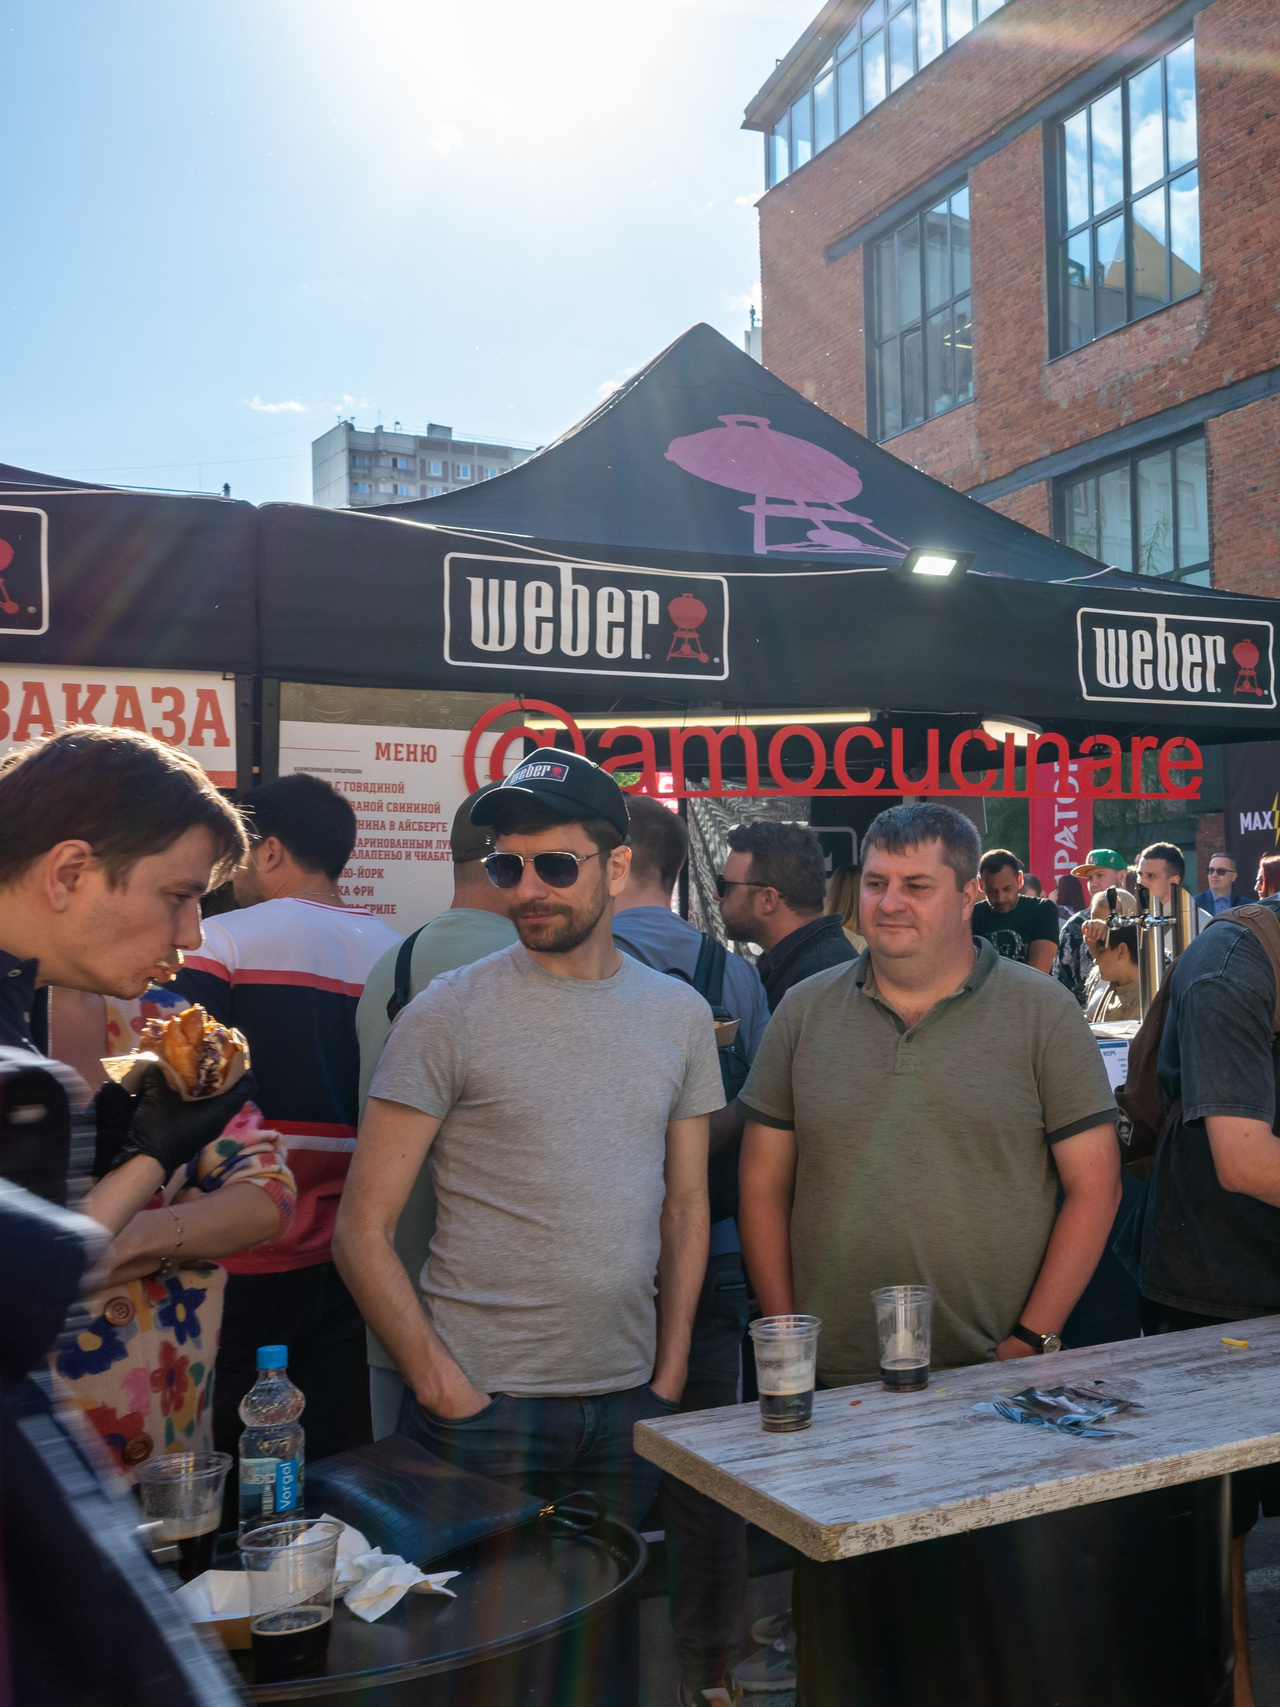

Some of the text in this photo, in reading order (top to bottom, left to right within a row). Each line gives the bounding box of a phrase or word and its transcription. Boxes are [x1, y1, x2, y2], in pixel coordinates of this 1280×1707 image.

[465, 564, 660, 660] weber
[1092, 616, 1227, 693] weber
[375, 742, 438, 763] МЕНЮ
[509, 764, 552, 785] weber
[334, 781, 342, 792] С
[343, 781, 404, 794] ГОВЯДИНОЙ
[349, 800, 441, 814] ВАНОЙ СВИНИНОЙ
[356, 818, 448, 833] НИНА В АЙСБЕРГЕ
[1054, 761, 1080, 886] РАТО
[349, 849, 403, 861] АЛАПЕНЬО
[404, 850, 412, 861] И
[337, 885, 375, 897] КА ФРИ
